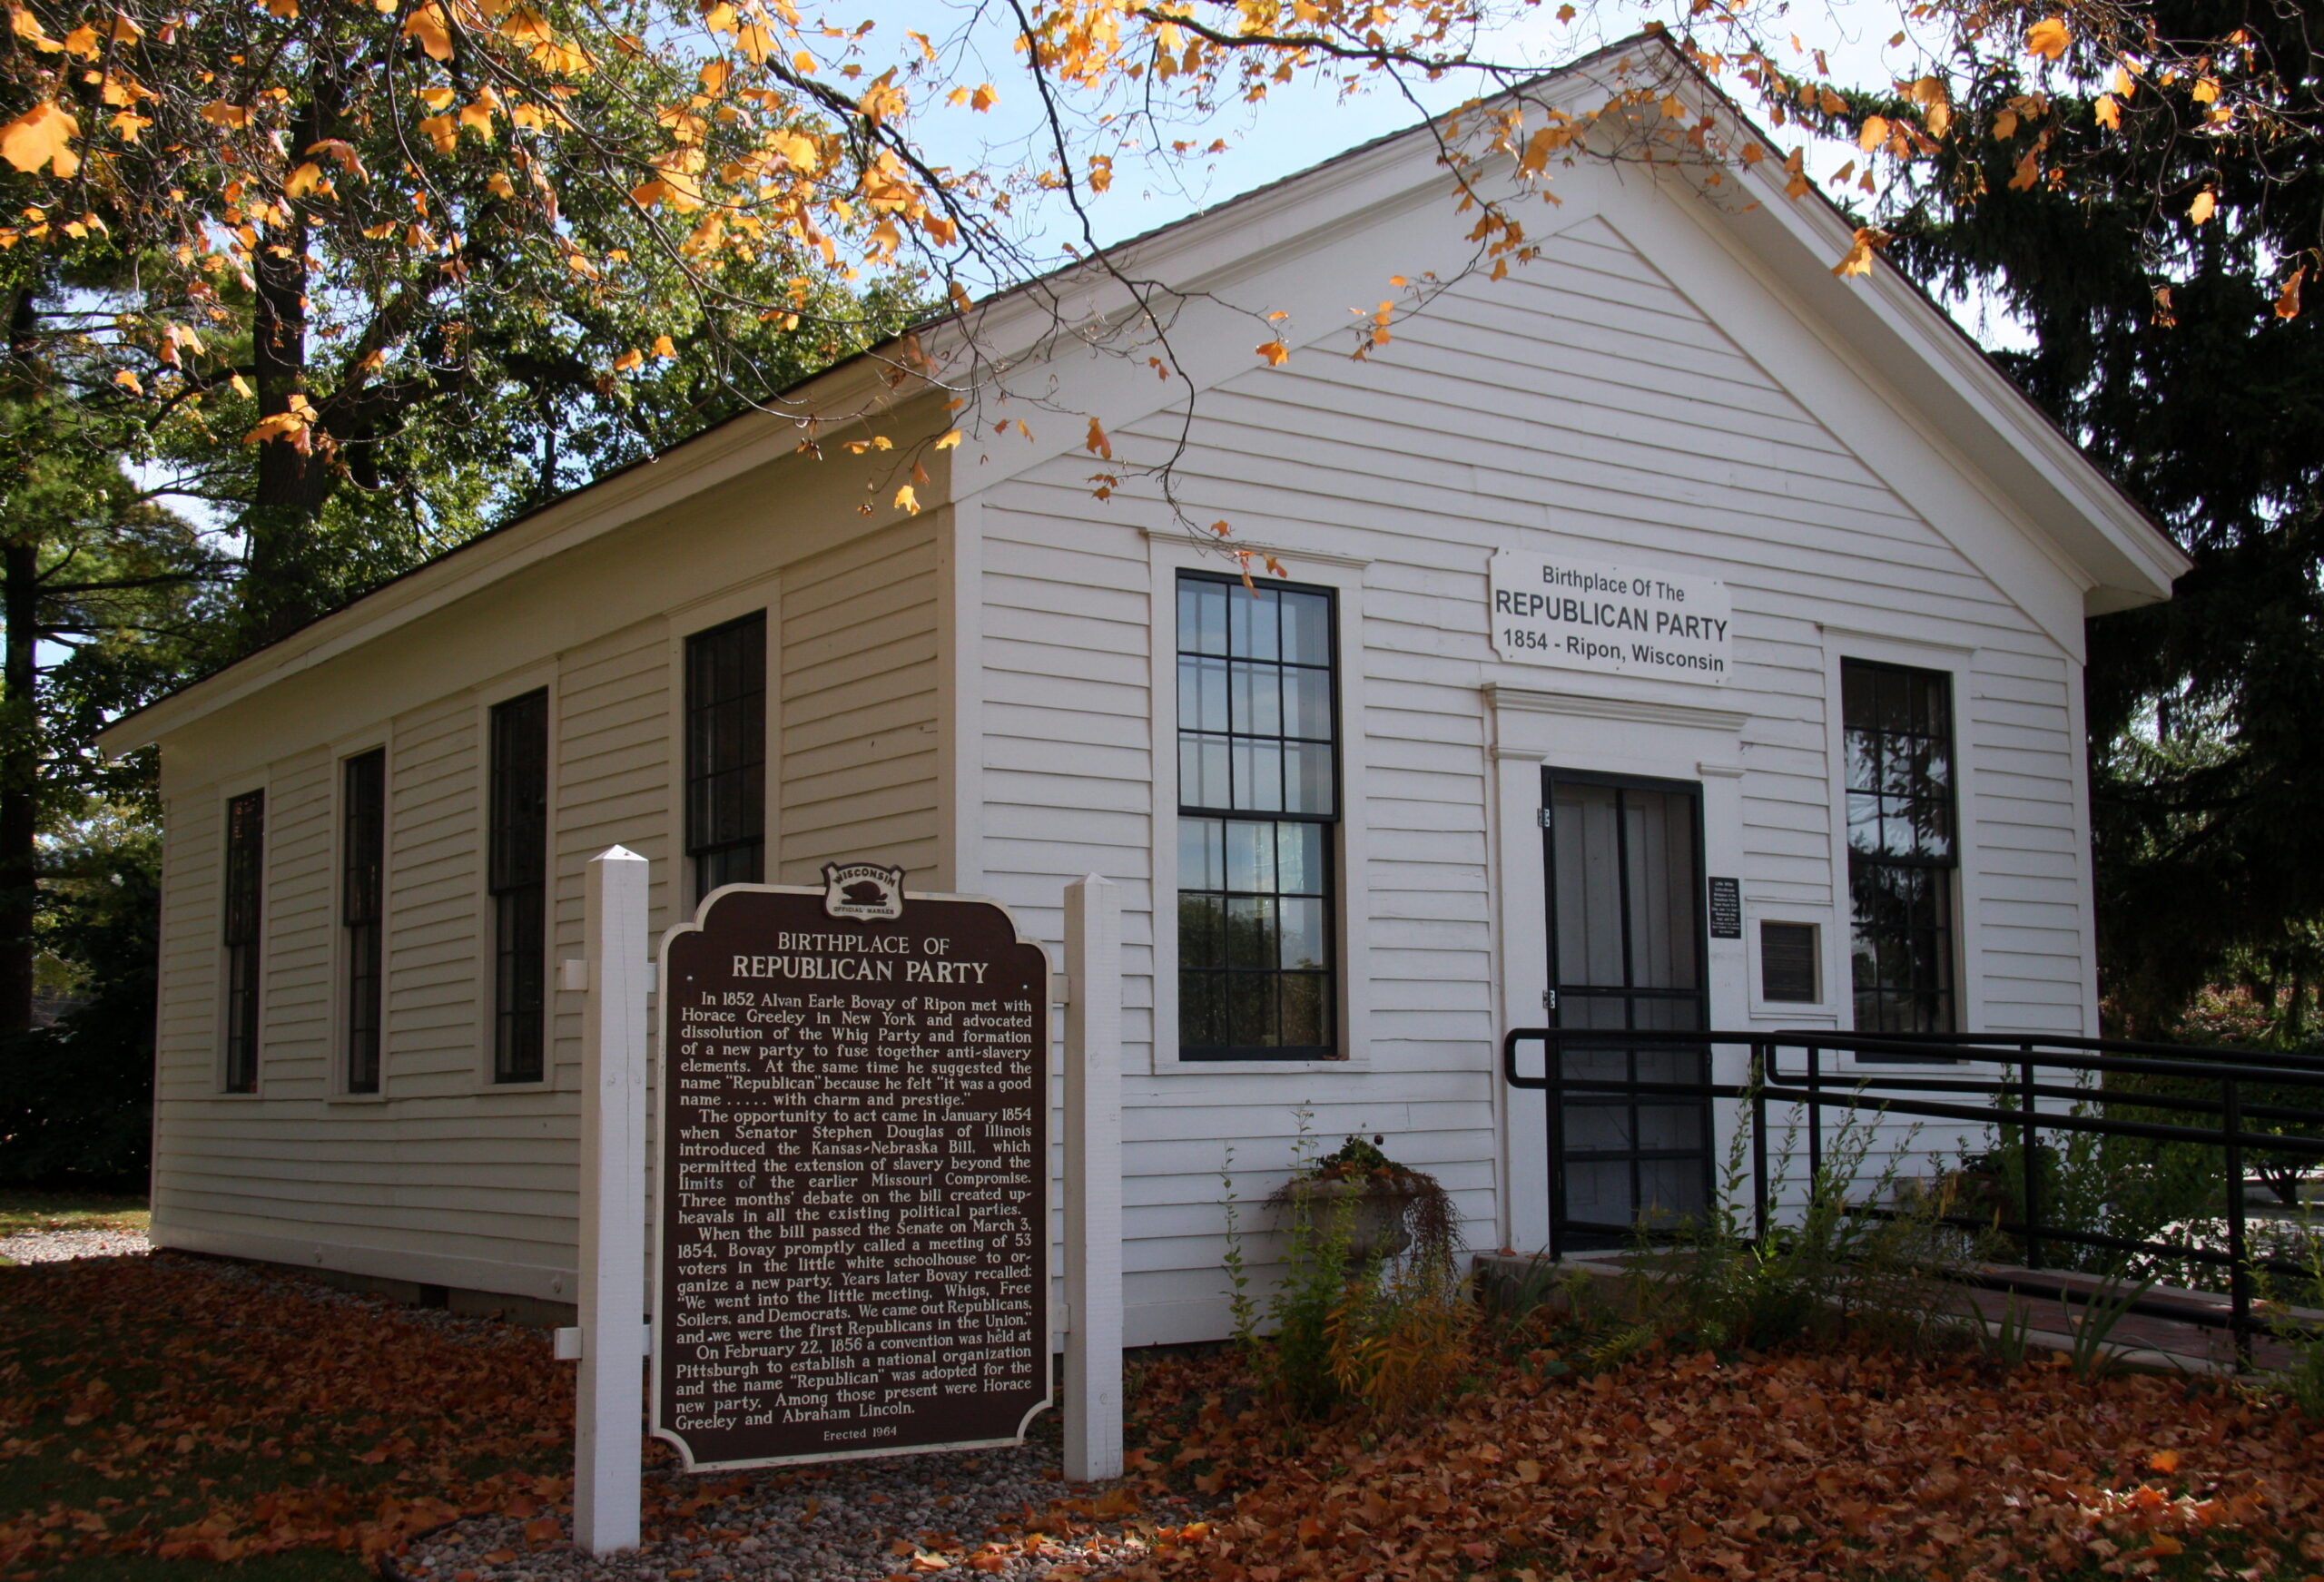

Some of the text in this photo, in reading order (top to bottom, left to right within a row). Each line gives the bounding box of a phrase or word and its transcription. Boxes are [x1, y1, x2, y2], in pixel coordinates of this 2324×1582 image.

[1542, 565, 1685, 602] Birthplace Of The
[1496, 589, 1728, 643] REPUBLICAN PARTY
[1502, 628, 1548, 650] 1854
[1566, 635, 1627, 663] Ripon,
[1631, 644, 1724, 672] Wisconsin
[833, 868, 897, 888] WISCONSIN
[777, 932, 950, 956] BIRTHPLACE OF
[731, 955, 989, 984] REPUBLICAN PARTY
[702, 992, 1031, 1014] In 1852 Alvan Earle Bovay of Ripon met with
[682, 1009, 1031, 1027] Horace Greeley in New York and advocated
[681, 1026, 1031, 1045] dissolution of the Whig Party and formation
[681, 1043, 1031, 1061] of a new party to fuse together anti-slavery
[680, 1059, 1031, 1077] elements. At the same time he suggested the
[698, 1108, 1031, 1126] The opportunity to act came in January 1854
[680, 1124, 1031, 1143] when Senator Stephen Douglas of Illinois
[679, 1155, 1030, 1178] permitted the extension of slavery beyond the
[678, 1187, 1031, 1207] Three months' debate on the bill created up-
[678, 1203, 1020, 1223] heavals in all the existing political parties.
[677, 1233, 1031, 1260] 1854, Bovay promptly called a meeting of 53
[678, 1252, 1030, 1275] voters in the little white schoolhouse to or-
[677, 1265, 1031, 1296] ganize a new party. Years later Bovay recalled:
[676, 1298, 1031, 1327] Soilers, and Democrats. We came out Republicans,
[696, 1329, 1031, 1360] On February 22, 1856 a convention was held at
[676, 1346, 1031, 1381] Pittsburgh to establish a national organization
[676, 1379, 1030, 1414] new party. Among those present were Horace
[675, 1401, 914, 1430] Greeley and Abraham Lincoln.
[824, 1426, 896, 1440] Erected 1964
